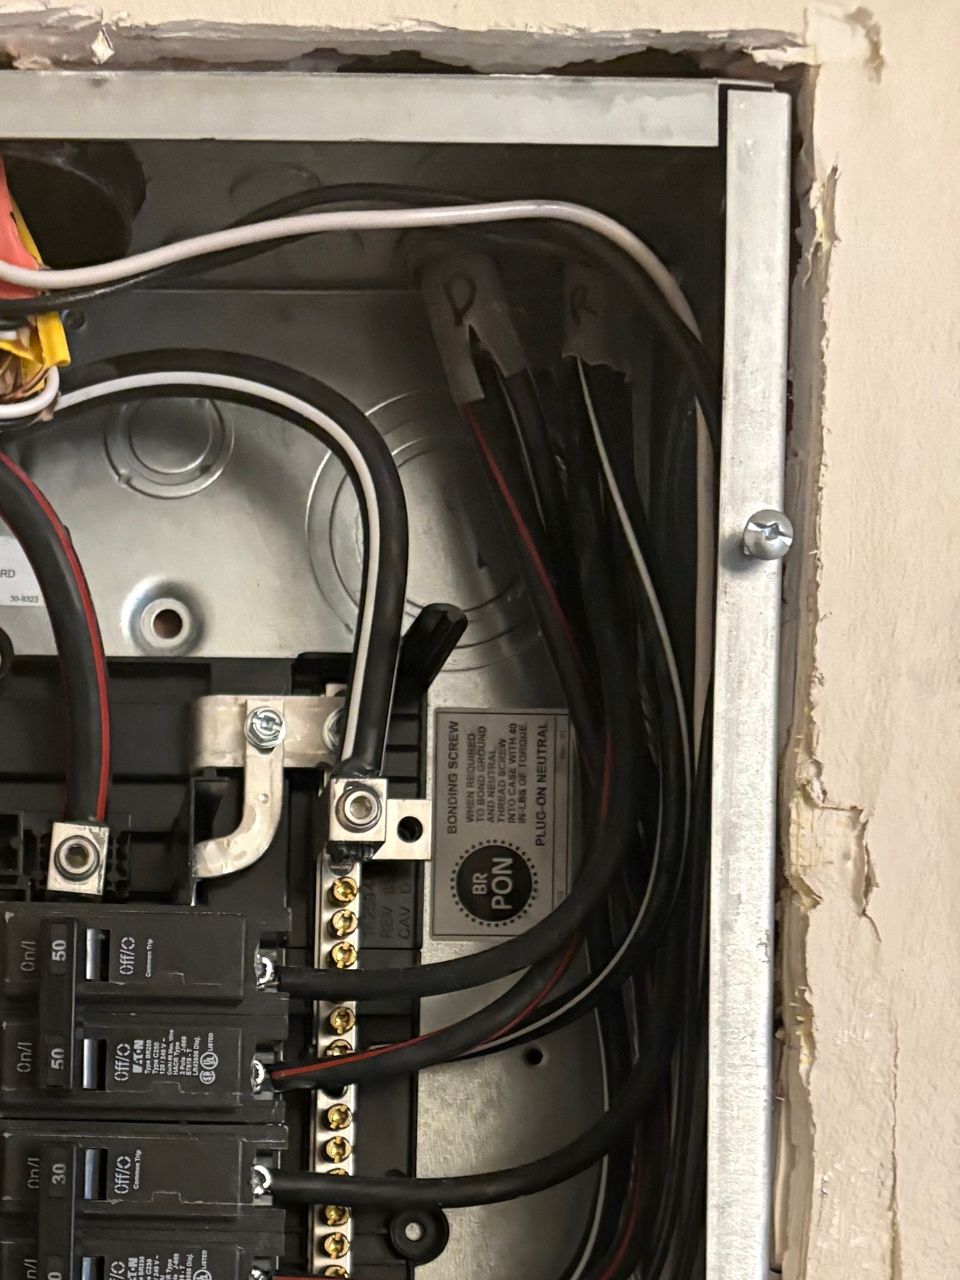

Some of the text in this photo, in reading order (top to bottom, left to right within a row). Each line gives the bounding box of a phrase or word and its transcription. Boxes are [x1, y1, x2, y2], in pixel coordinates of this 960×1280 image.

[447, 720, 459, 834] BONDING SCREW
[466, 732, 476, 823] WHEN REQUIRED
[476, 725, 487, 823] TO BOND GROUND
[497, 738, 507, 823] THREAD SCREW
[507, 723, 518, 823] INTO CASE WITH 40
[518, 772, 527, 786] OF
[535, 723, 548, 847] PLUG-ON NEUTRAL
[487, 799, 496, 823] AND
[472, 872, 488, 895] BR
[491, 857, 513, 910] PON
[52, 939, 67, 962] 50
[51, 1048, 64, 1070] 50
[52, 1163, 66, 1184] 30
